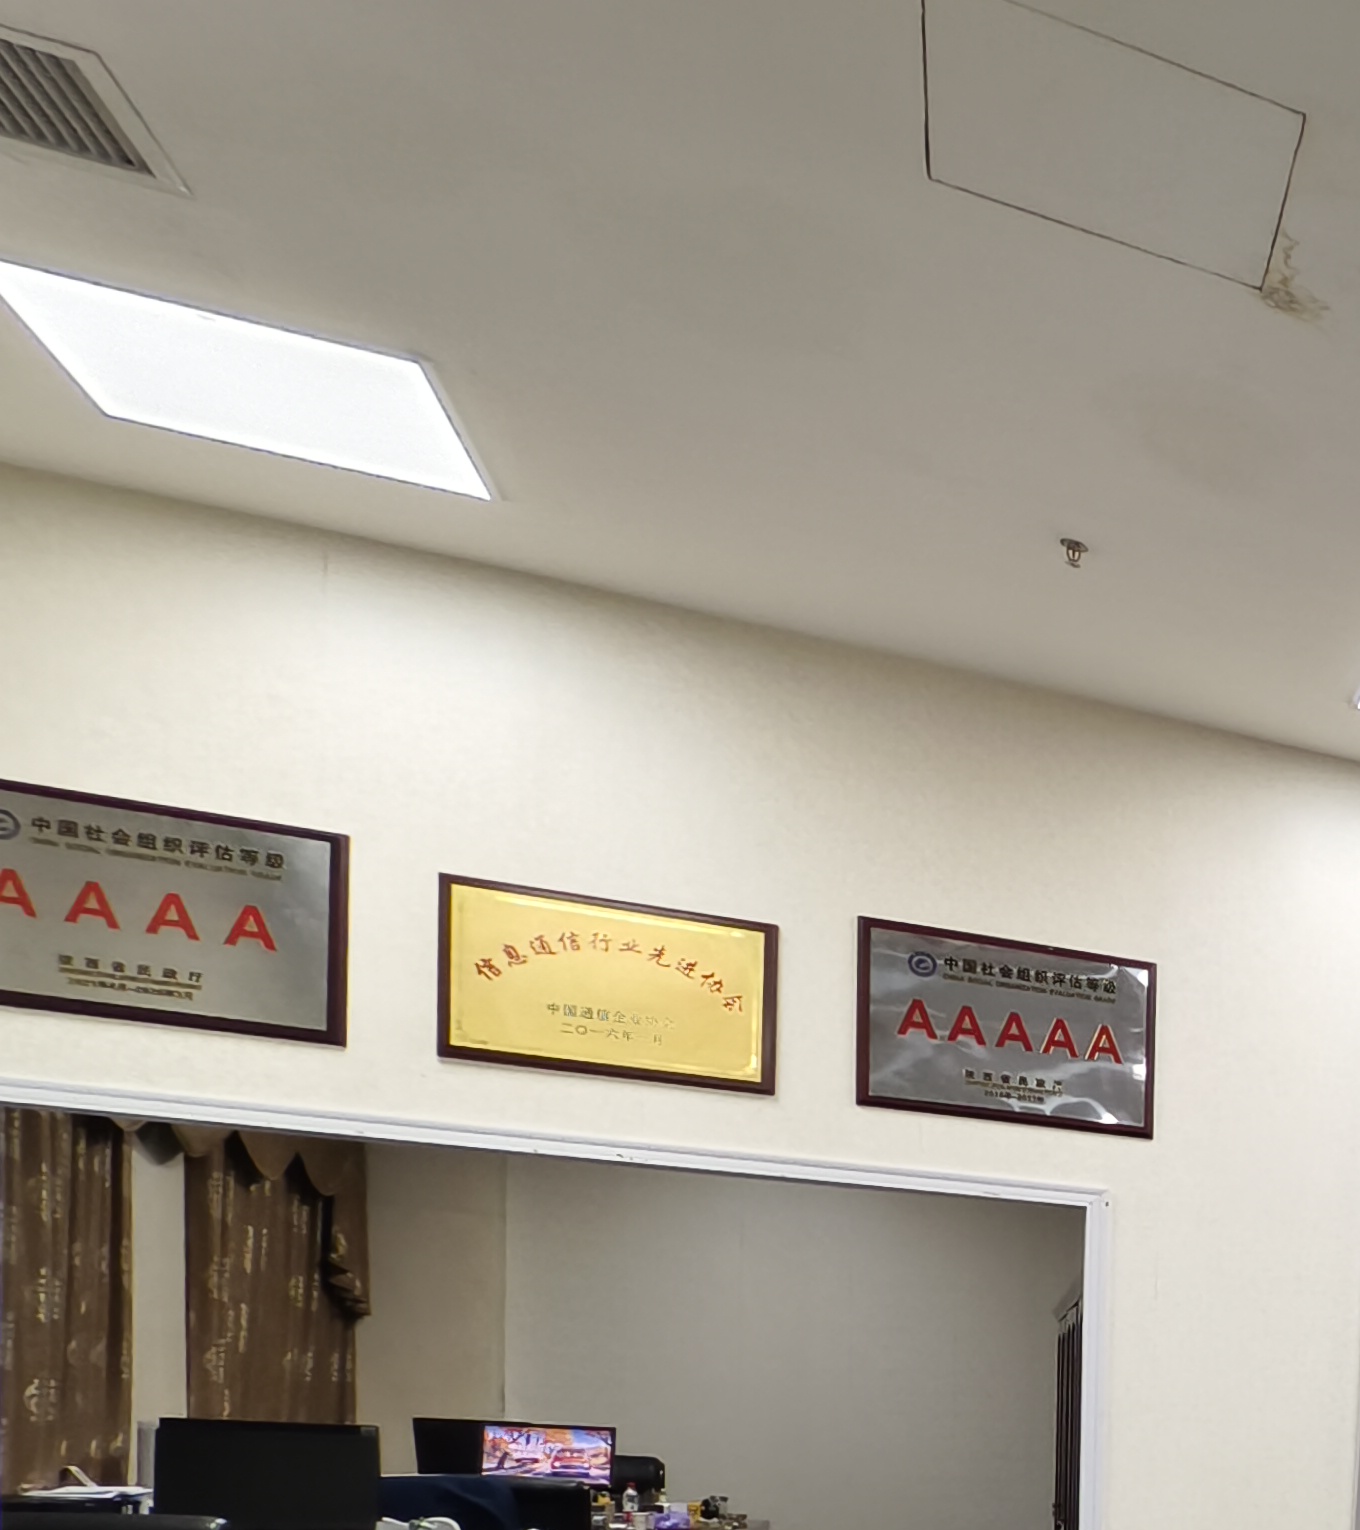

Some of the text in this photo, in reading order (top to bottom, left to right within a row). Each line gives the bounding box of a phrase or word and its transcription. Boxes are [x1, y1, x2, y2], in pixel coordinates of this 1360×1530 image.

[31, 816, 285, 871] 中国社会组织评估等级
[474, 931, 744, 1014] 信息通信行业先进协会
[943, 956, 1117, 995] 中国社会组织评估等级
[897, 998, 1123, 1064] AAAAA
